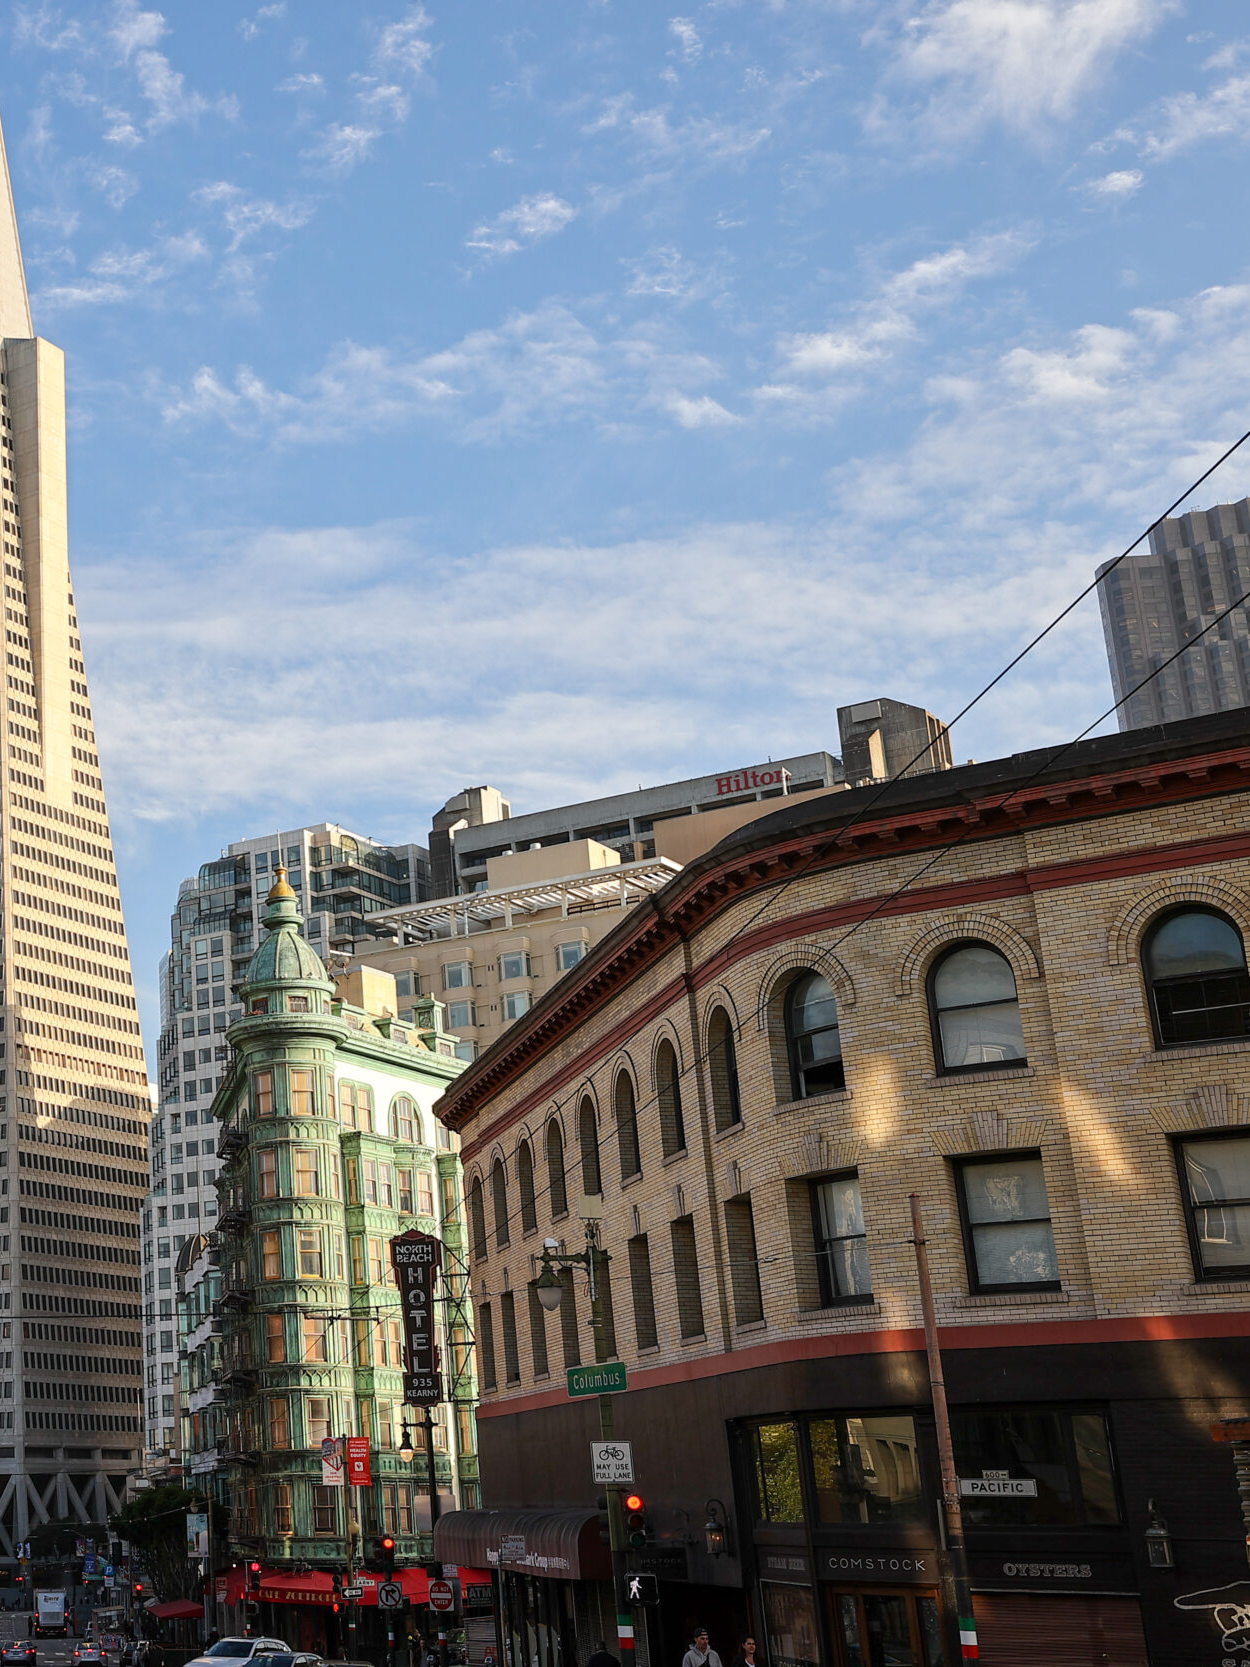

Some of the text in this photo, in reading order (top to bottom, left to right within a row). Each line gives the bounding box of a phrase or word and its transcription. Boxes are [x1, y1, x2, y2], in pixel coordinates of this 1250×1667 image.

[715, 770, 791, 795] Hilton
[395, 1244, 432, 1254] NORTH
[396, 1253, 433, 1263] BEACH
[407, 1267, 431, 1373] HOTEL
[412, 1378, 433, 1387] 935
[573, 1371, 620, 1390] Columbus
[407, 1389, 439, 1397] KEARNY
[971, 1482, 1024, 1493] PACIFIC
[828, 1557, 927, 1571] COMSTOCK
[1002, 1562, 1093, 1578] OYSTERS
[468, 1587, 492, 1598] ATM
